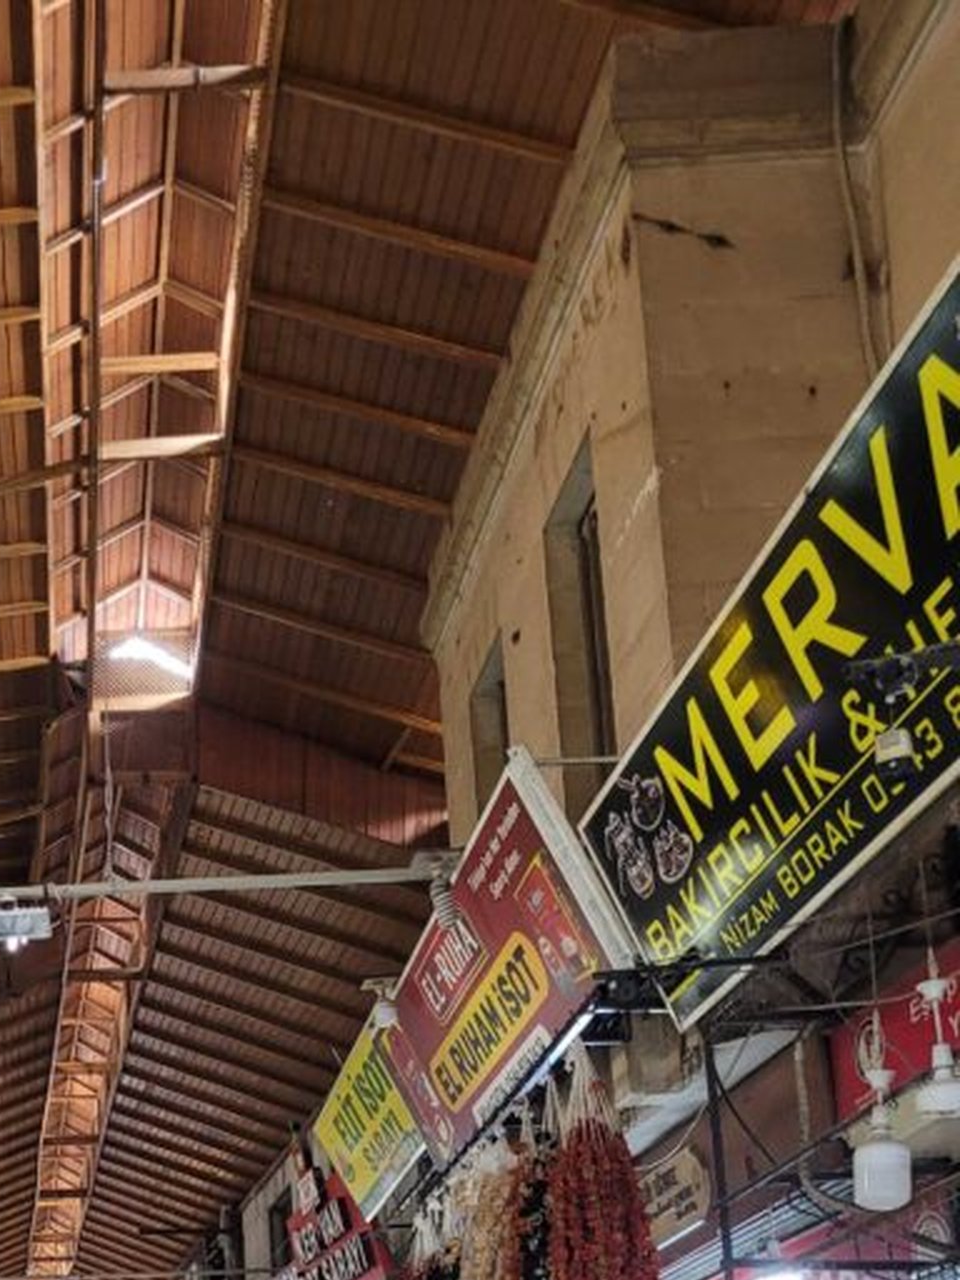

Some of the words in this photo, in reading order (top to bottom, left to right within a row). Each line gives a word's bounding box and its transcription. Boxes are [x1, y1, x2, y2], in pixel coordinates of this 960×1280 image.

[645, 732, 841, 965] BAKIRCILIK
[842, 690, 888, 752] &
[776, 800, 863, 898] BORAK
[434, 1061, 464, 1104] EL
